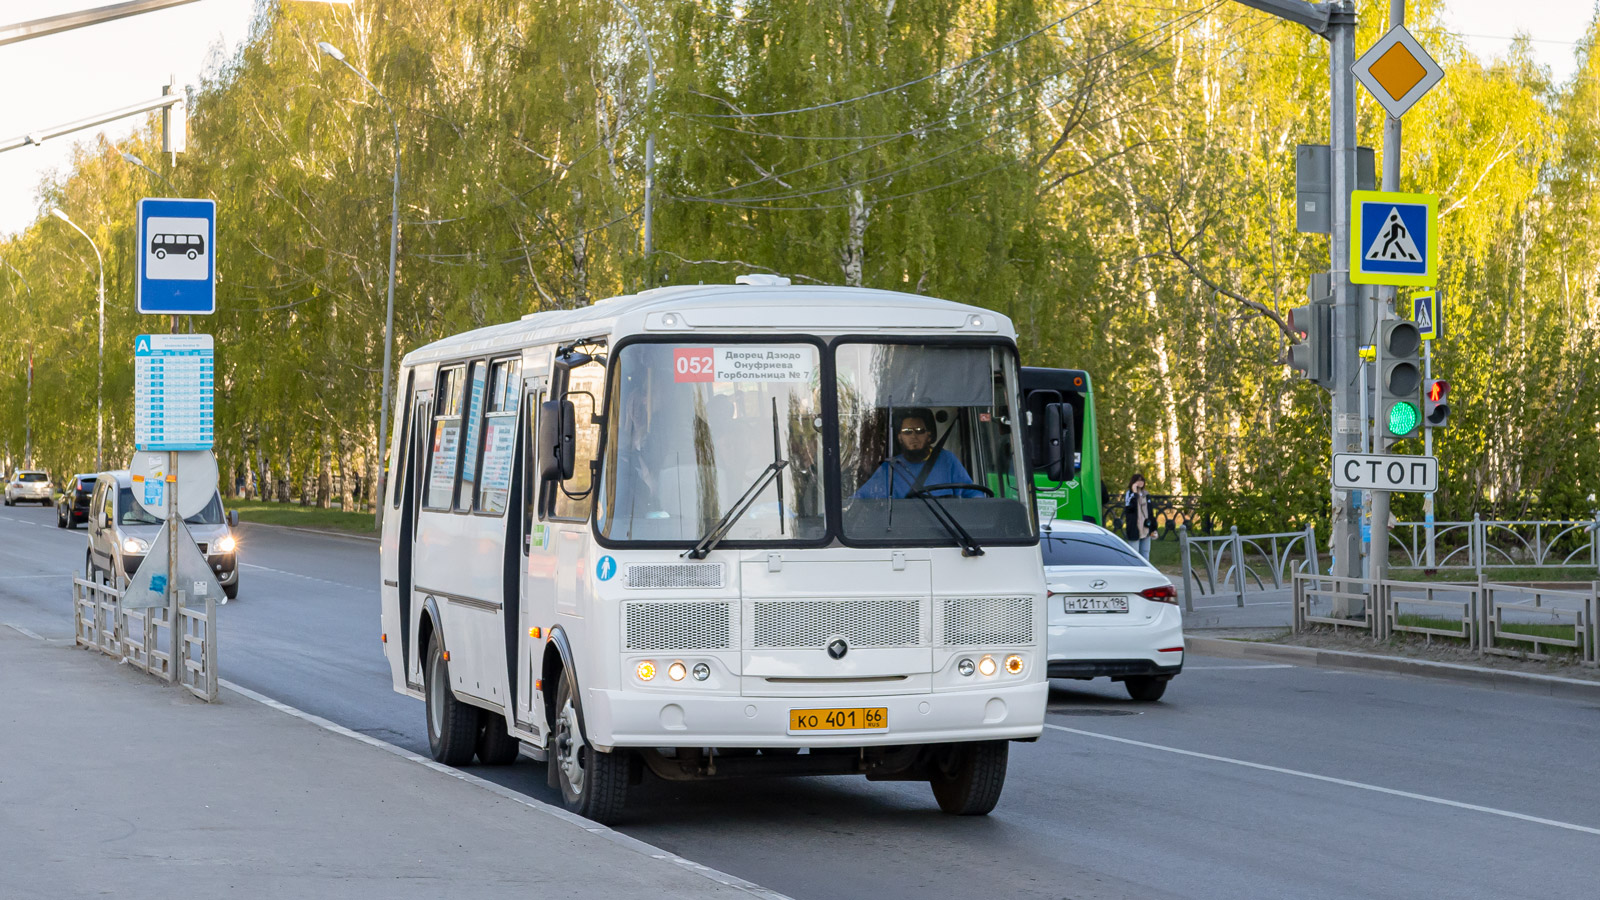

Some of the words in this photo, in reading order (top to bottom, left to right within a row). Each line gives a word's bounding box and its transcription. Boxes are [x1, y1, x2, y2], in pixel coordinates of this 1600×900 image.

[725, 351, 763, 360] Дворец
[766, 351, 801, 360] Дзюдо
[676, 356, 713, 374] 052
[734, 361, 793, 370] Онуфриева
[717, 371, 786, 379] Горбольница
[789, 371, 801, 379] №
[1344, 459, 1427, 486] СТОП
[825, 710, 855, 727] 401
[866, 709, 882, 722] 66
